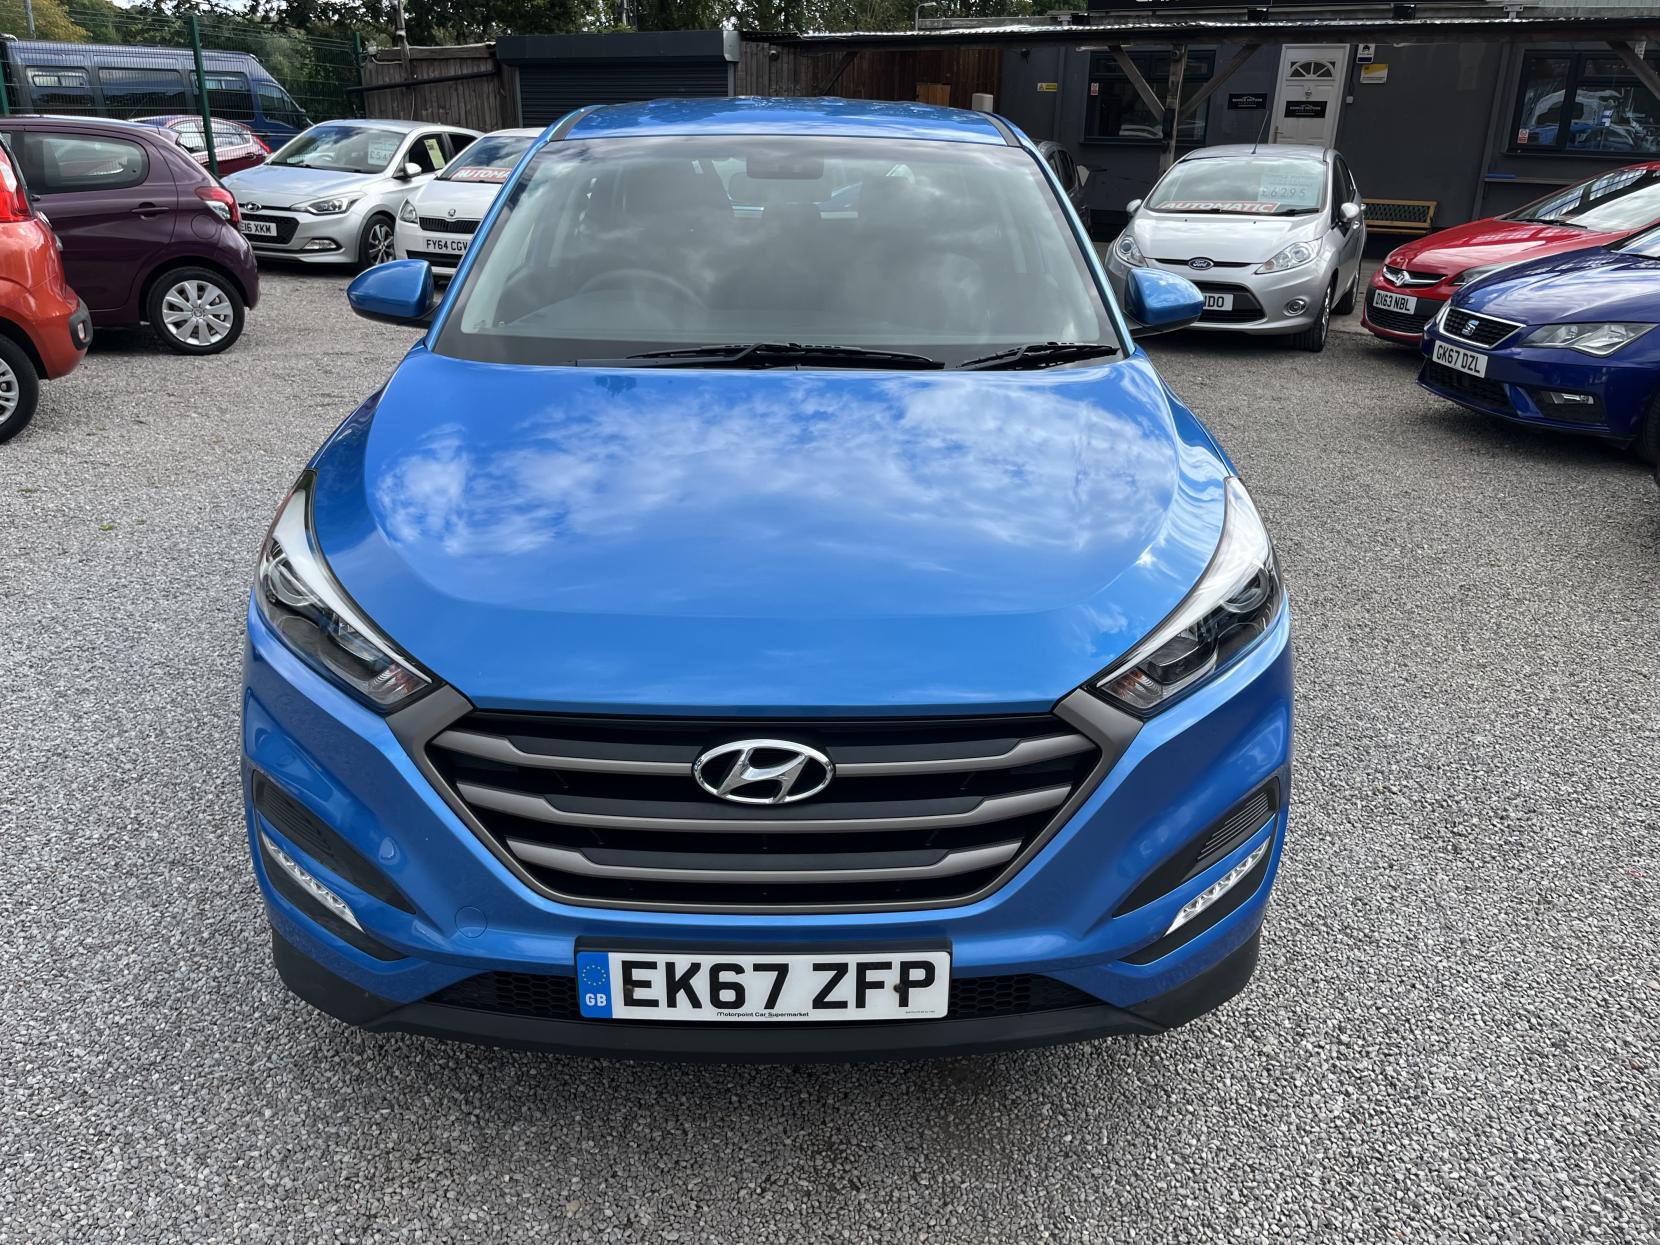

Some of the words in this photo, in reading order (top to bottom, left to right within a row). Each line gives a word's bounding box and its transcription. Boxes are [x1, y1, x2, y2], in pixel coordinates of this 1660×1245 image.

[1163, 202, 1273, 213] AUTOMATIC
[254, 223, 272, 235] XKM
[426, 239, 449, 250] FY64
[450, 240, 468, 251] CGV
[1393, 296, 1411, 312] NBL
[1436, 344, 1460, 367] GK67
[1460, 352, 1481, 374] DZL
[621, 959, 790, 1010] EK67
[811, 959, 936, 1010] ZFP
[584, 993, 607, 1007] GB
